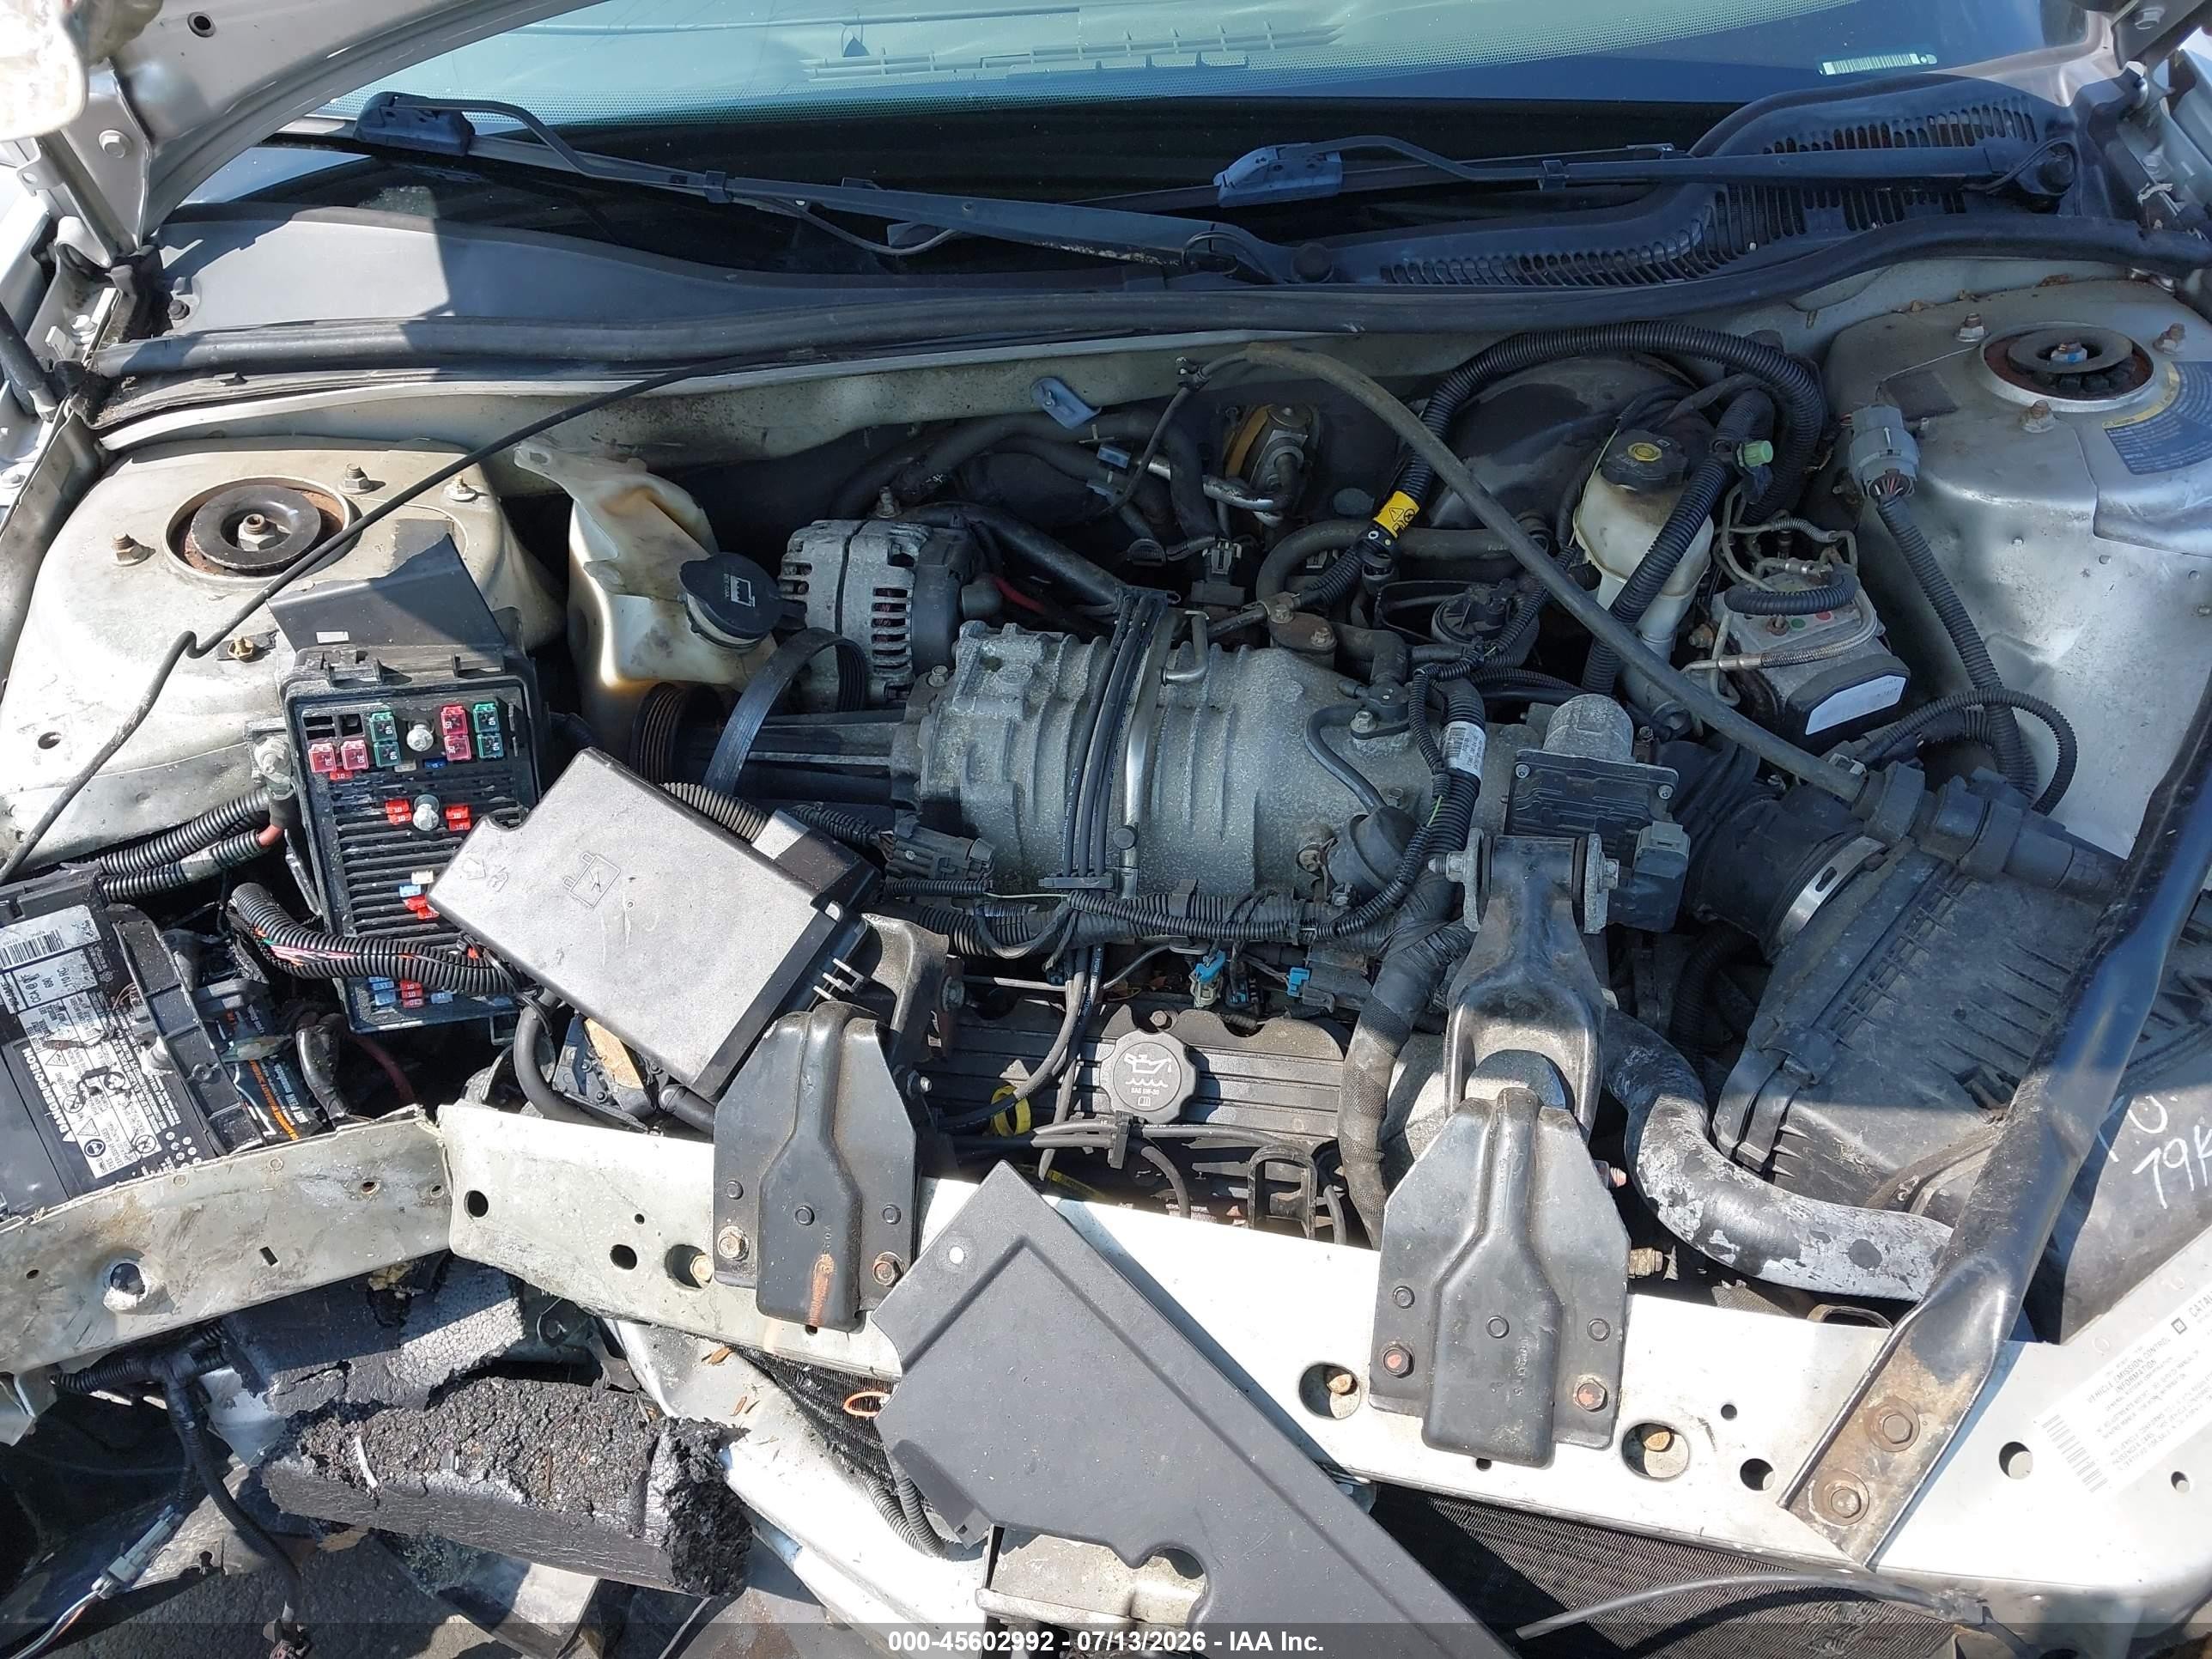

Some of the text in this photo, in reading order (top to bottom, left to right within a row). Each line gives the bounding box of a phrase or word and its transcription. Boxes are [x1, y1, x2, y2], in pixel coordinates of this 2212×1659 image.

[28, 989, 40, 1003] CCA
[42, 976, 54, 988] 690
[22, 1048, 69, 1131] DANGER/POISON
[2086, 1381, 2114, 1404] VEHICLE
[2112, 1357, 2145, 1383] EMISSION
[2142, 1335, 2172, 1360] CONTROL
[2113, 1358, 2158, 1393] INFORMATION
